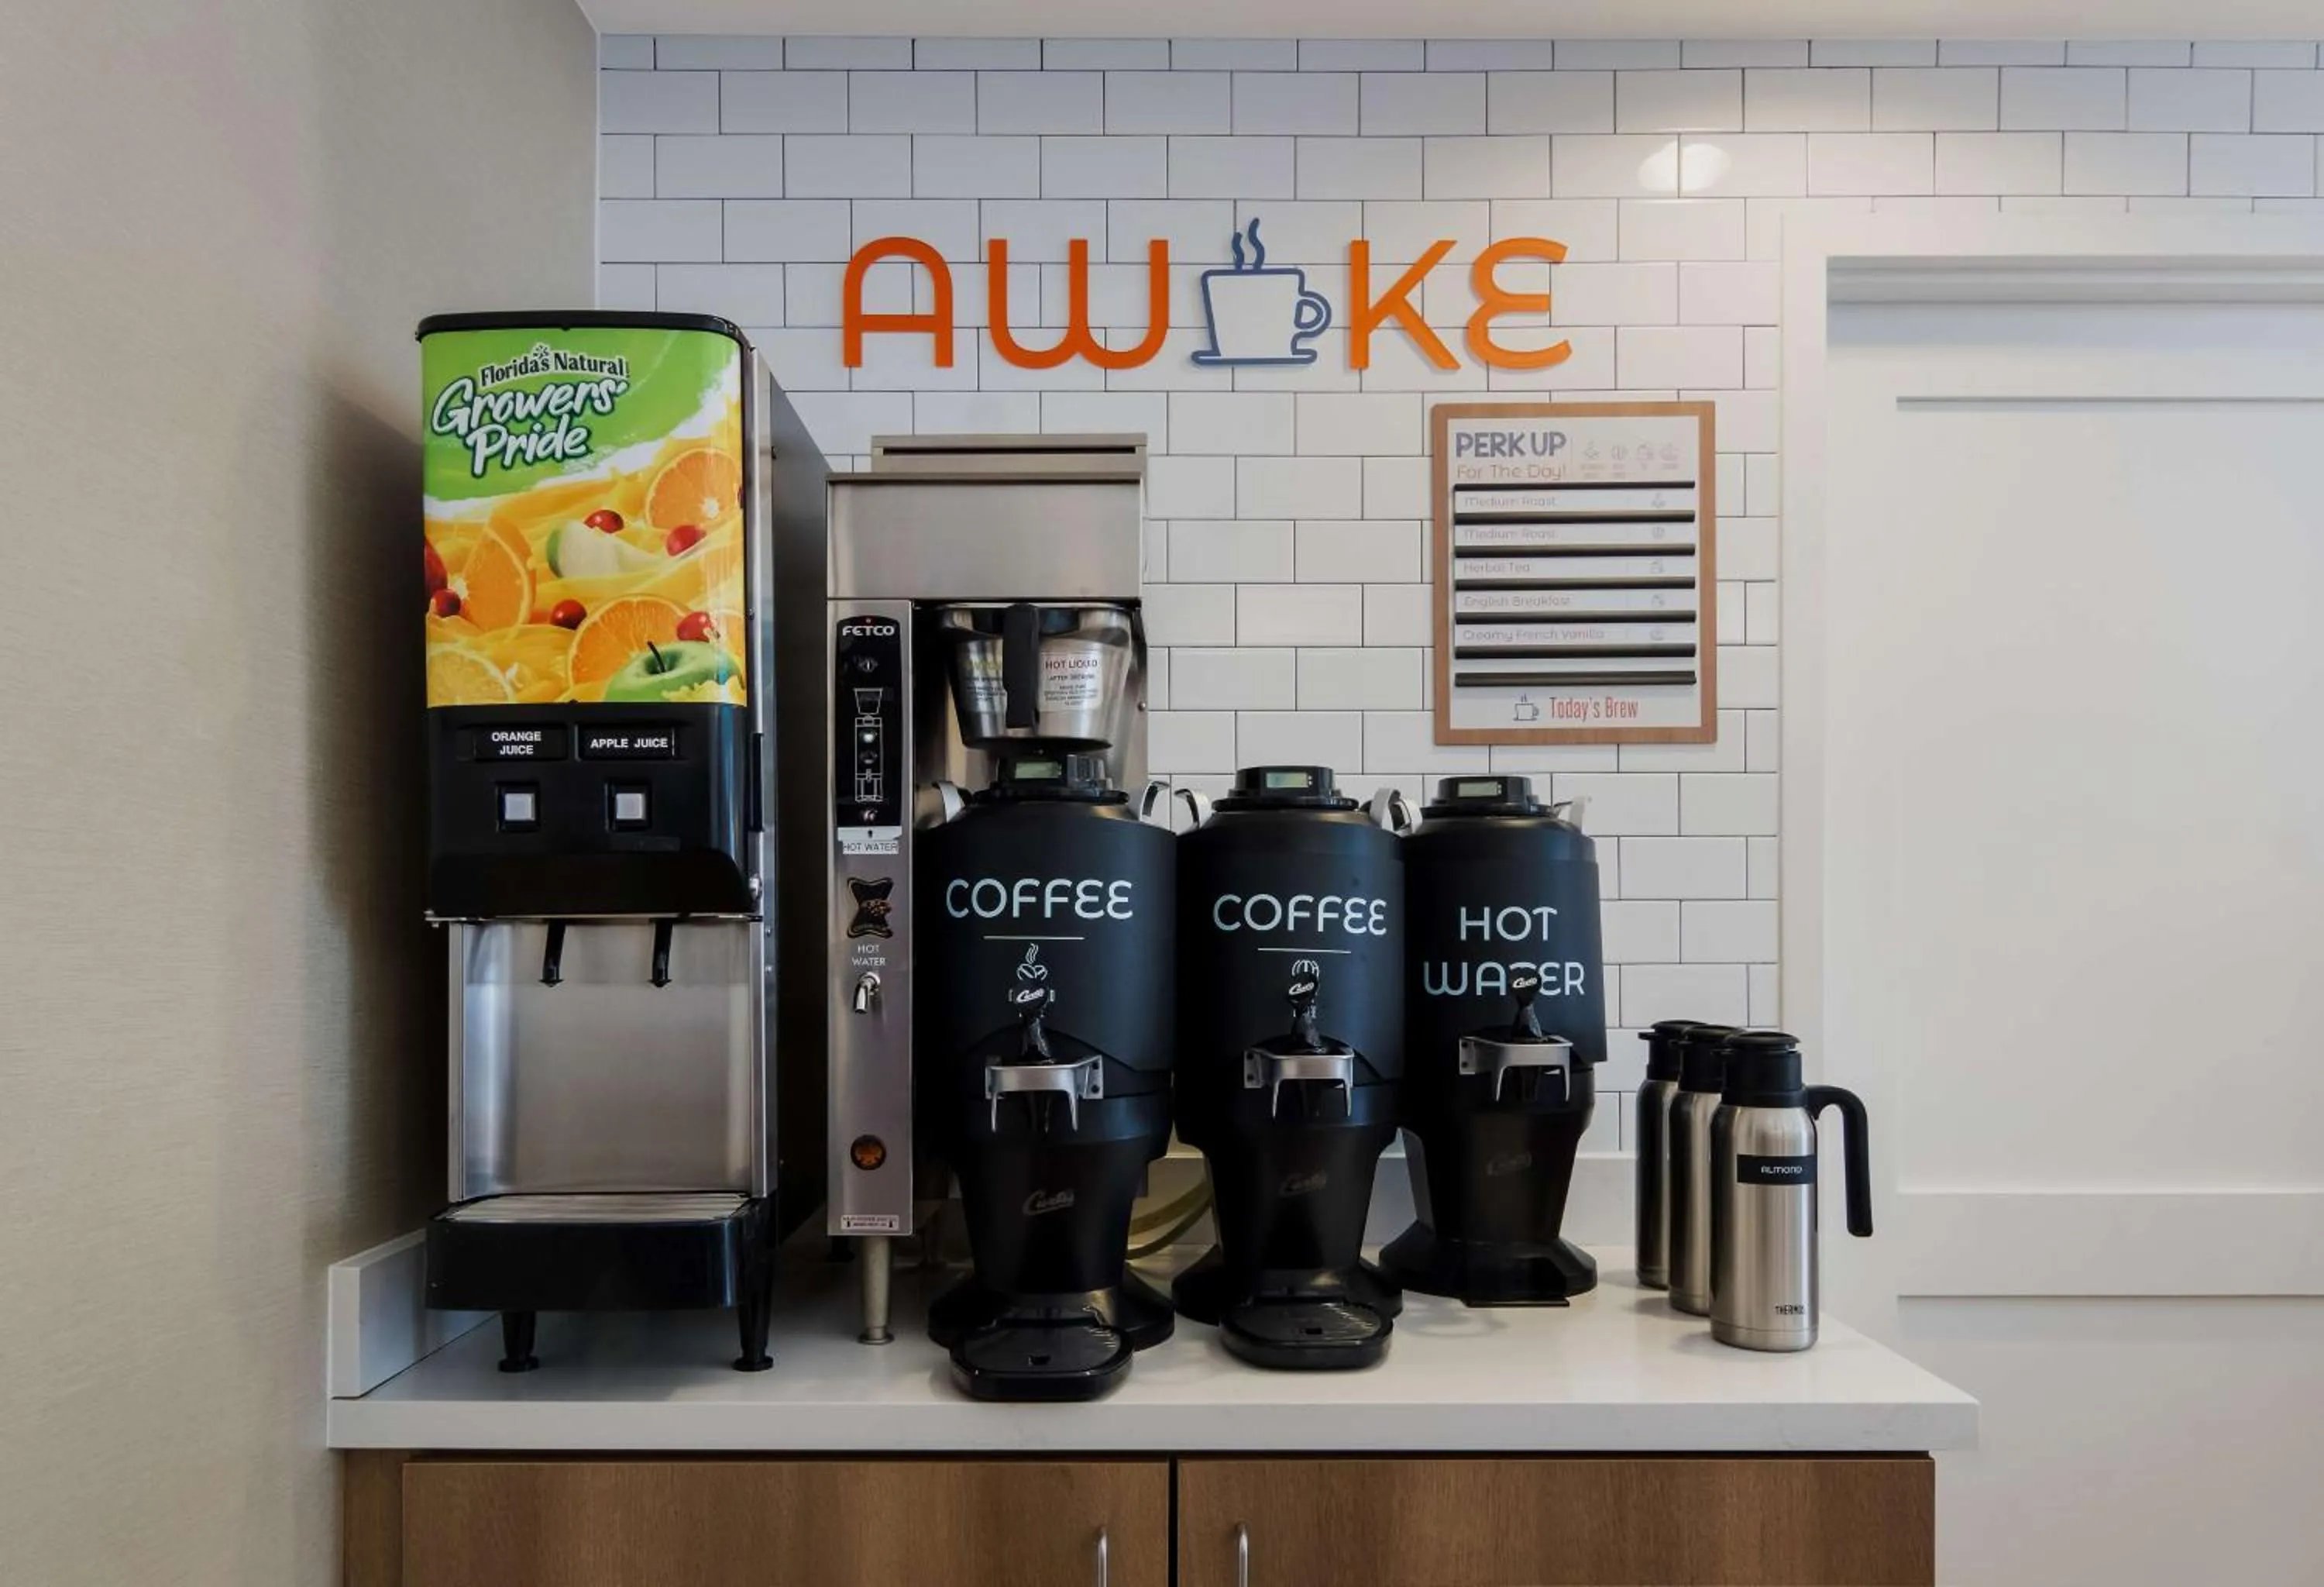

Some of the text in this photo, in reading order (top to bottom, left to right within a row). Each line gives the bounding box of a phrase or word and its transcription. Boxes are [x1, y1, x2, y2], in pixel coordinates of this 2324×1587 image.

[480, 353, 549, 386] Florida's
[466, 412, 592, 478] Pride
[1456, 432, 1566, 458] PERK UP
[1456, 465, 1483, 480] For
[1491, 464, 1523, 479] The
[1526, 464, 1566, 481] Day!
[1464, 495, 1556, 507] Medium Roast
[1464, 528, 1516, 539] Medium
[1463, 561, 1530, 573] Herbal Tea
[1463, 595, 1570, 609] English Breakfast
[842, 625, 895, 636] FETCO
[1463, 628, 1605, 642] Creamy French Vanilla
[1046, 660, 1066, 670] HOT
[1549, 696, 1638, 722] Today's Brew
[491, 731, 541, 742] ORANGE
[590, 737, 669, 749] APPLE JUICE
[500, 745, 535, 756] JUICE
[843, 842, 897, 852] HOT WATER
[946, 878, 1133, 919] COFFEE
[1213, 893, 1387, 935] COFFEE
[1460, 906, 1558, 942] HOT
[858, 944, 880, 954] HOT
[852, 957, 886, 967] WATER
[1761, 1165, 1803, 1175] ALMOND
